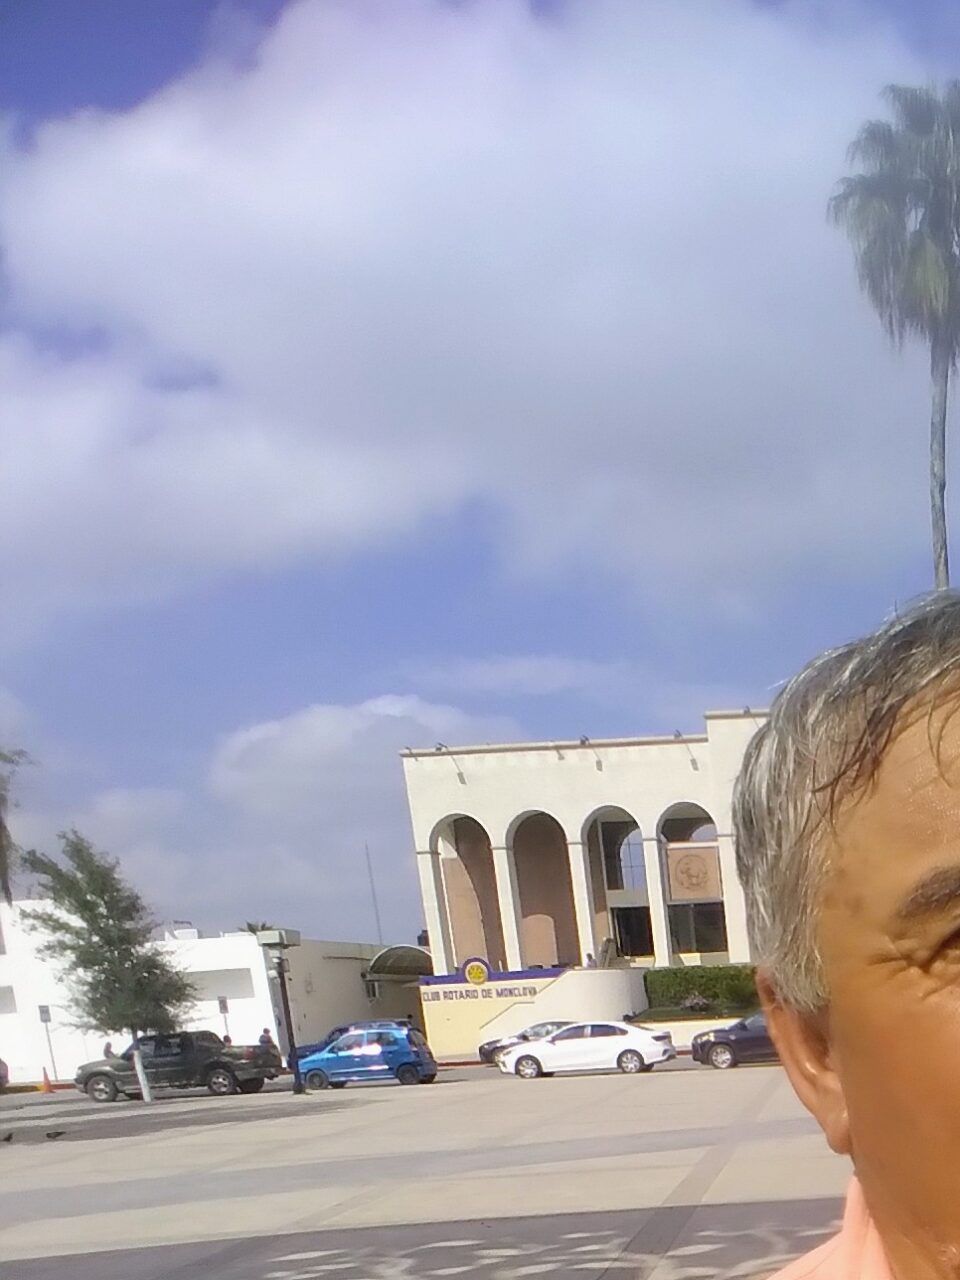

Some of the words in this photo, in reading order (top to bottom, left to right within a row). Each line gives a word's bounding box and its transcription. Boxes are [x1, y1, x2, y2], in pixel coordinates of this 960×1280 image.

[423, 991, 440, 1002] CLUB
[443, 989, 479, 1000] ROTARIO
[481, 988, 494, 998] DE
